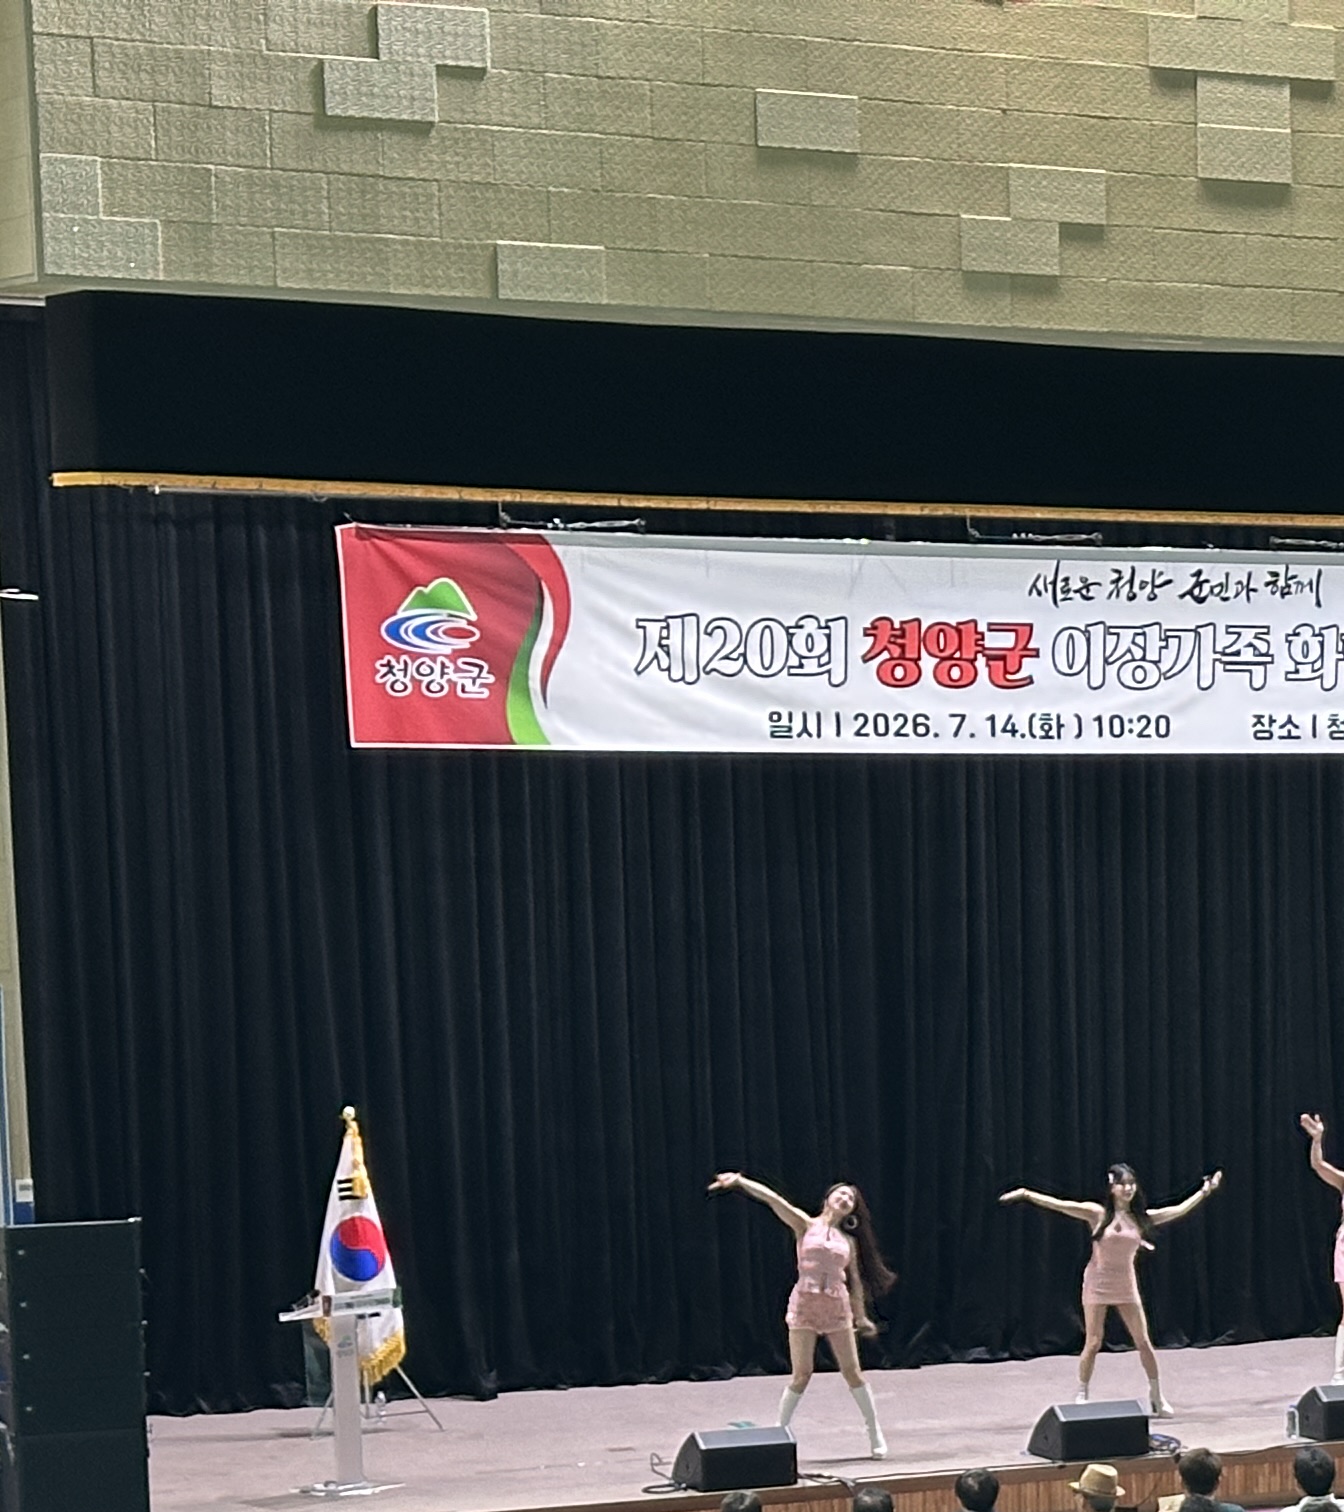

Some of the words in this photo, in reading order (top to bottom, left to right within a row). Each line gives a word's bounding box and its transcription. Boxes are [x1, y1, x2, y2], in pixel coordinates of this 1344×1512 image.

[1027, 559, 1102, 608] 새로운
[1106, 565, 1173, 603] 청양
[1178, 568, 1258, 604] 군민과
[1264, 563, 1322, 608] 함께
[634, 613, 848, 688] 제20회
[861, 616, 1040, 690] 청양군
[1051, 621, 1275, 691] 이장가족
[375, 655, 495, 698] 청양군
[767, 711, 822, 740] 일시
[1092, 714, 1171, 740] 10:20
[1251, 713, 1302, 741] 장소
